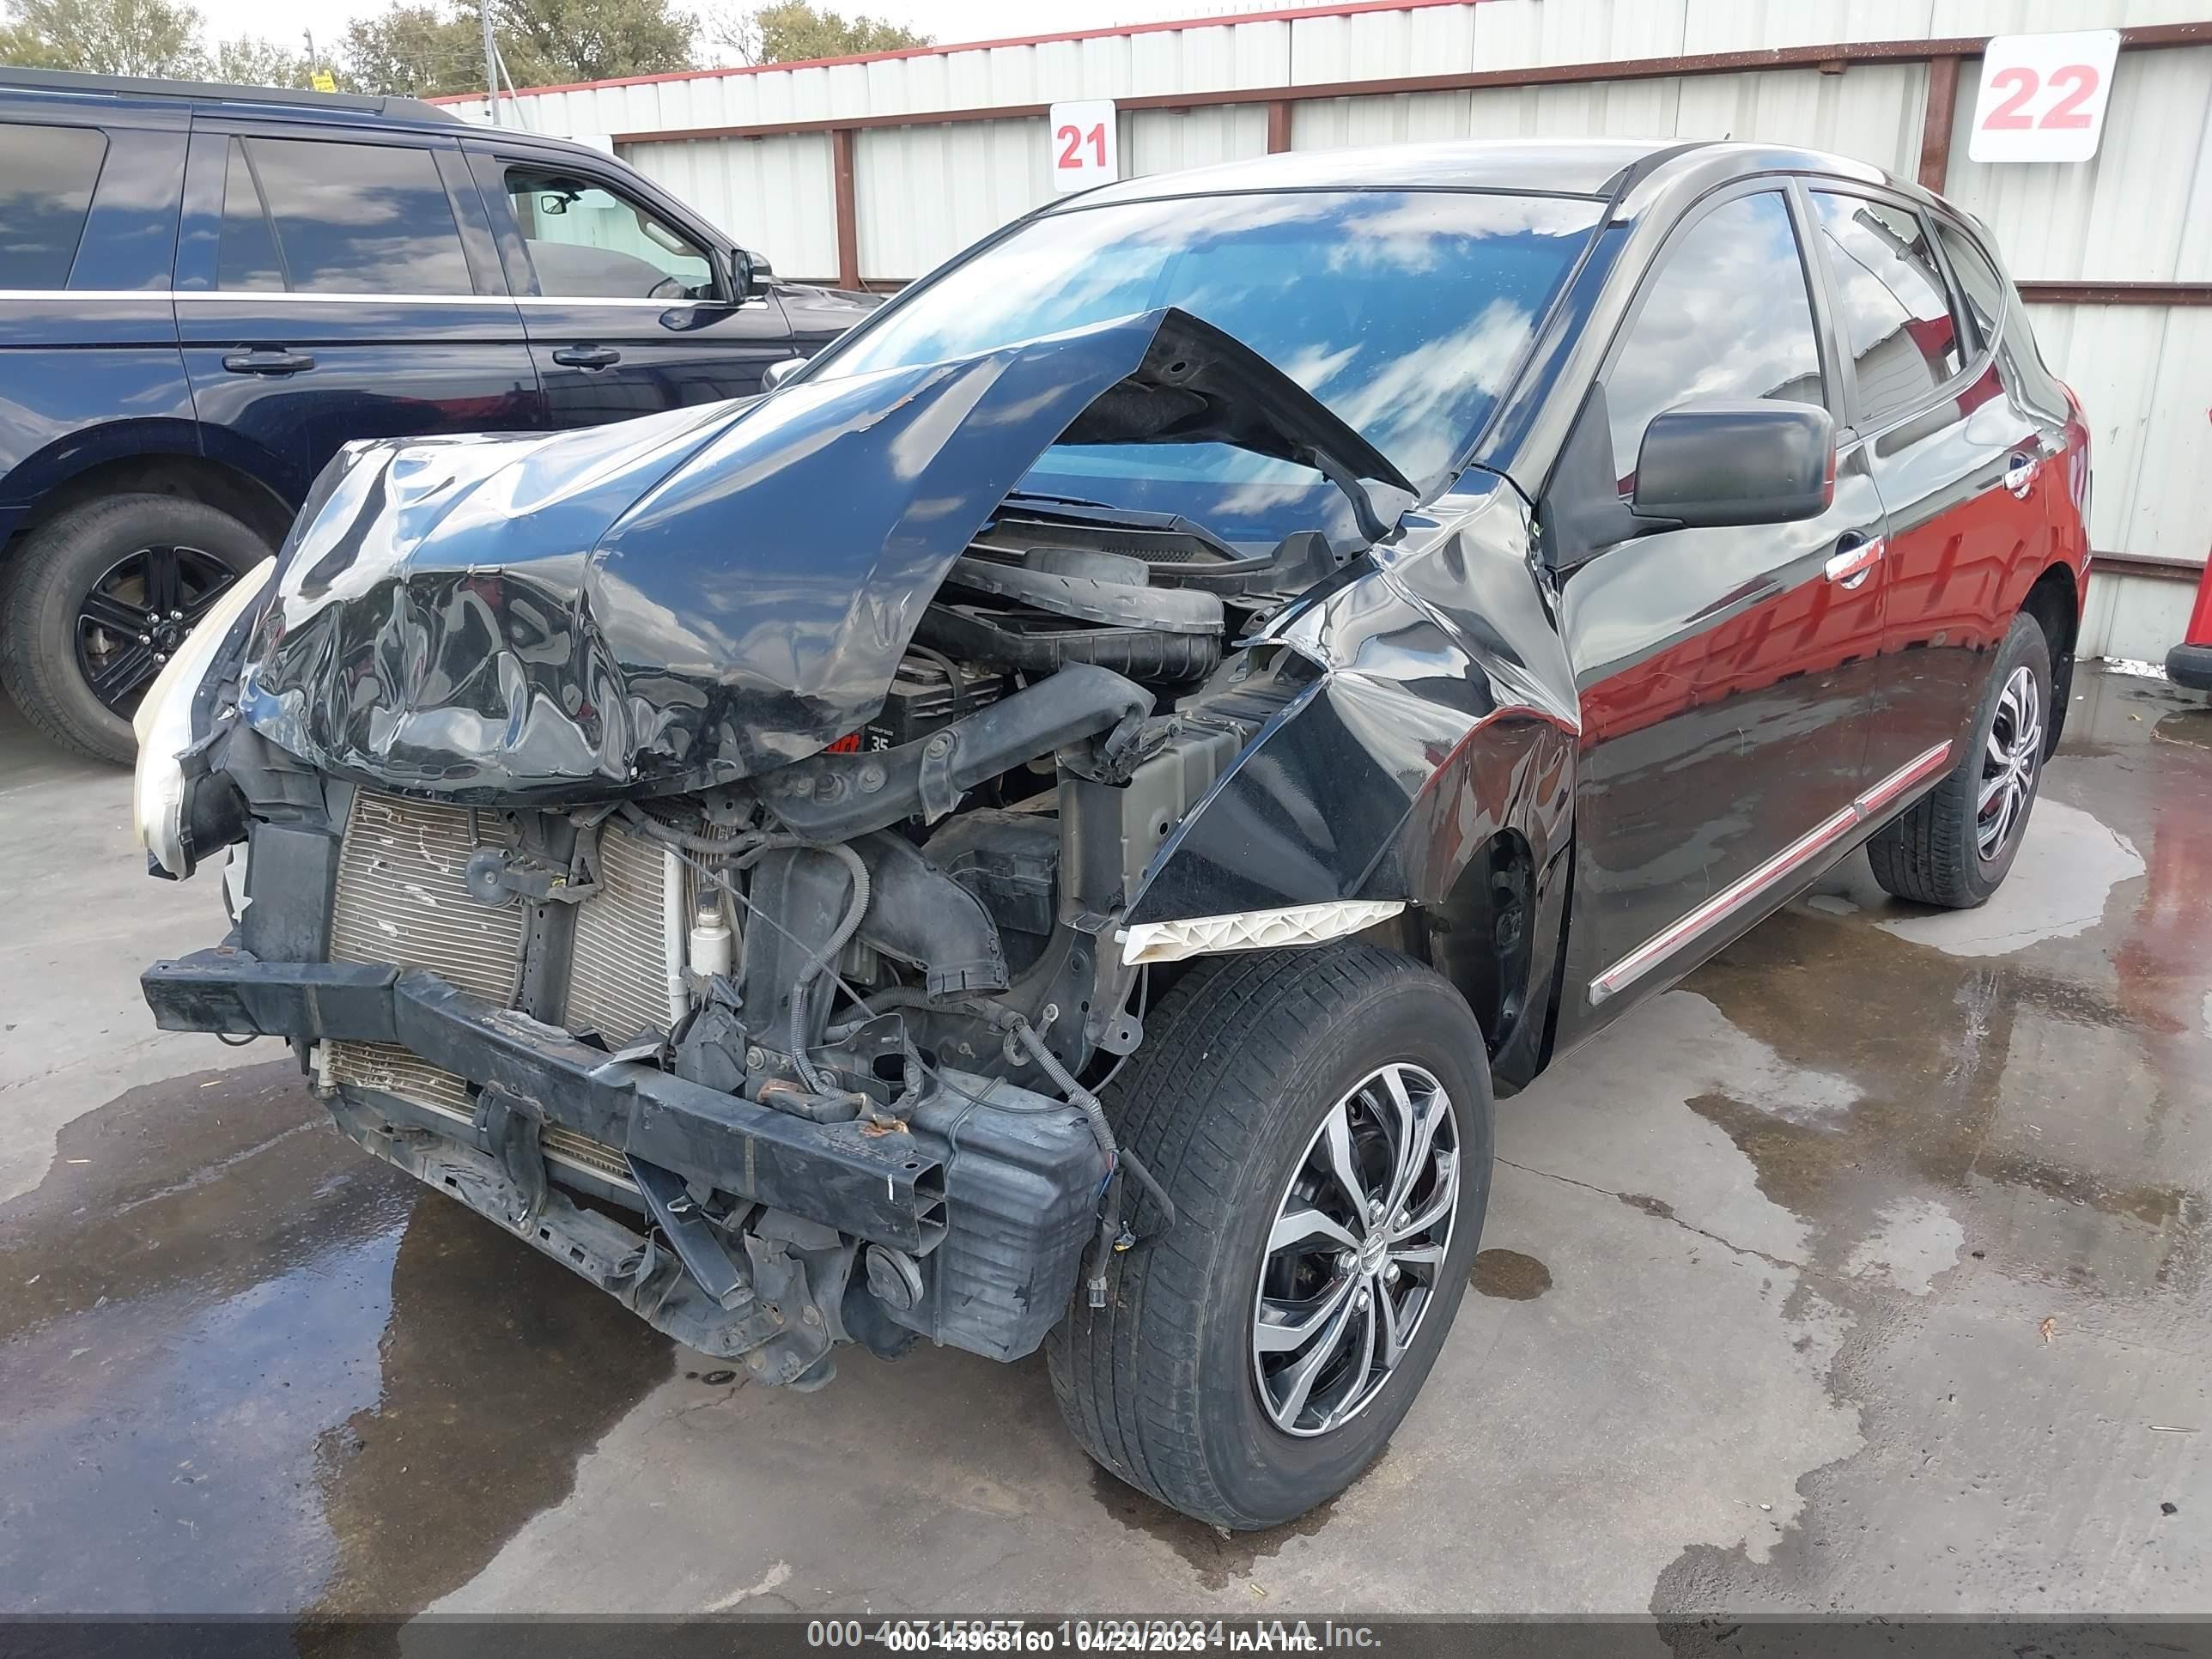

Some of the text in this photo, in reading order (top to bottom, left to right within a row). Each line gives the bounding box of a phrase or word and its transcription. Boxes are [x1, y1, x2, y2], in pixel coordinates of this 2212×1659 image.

[1981, 64, 2100, 131] 22
[1057, 123, 1106, 169] 21
[871, 736, 889, 752] 35
